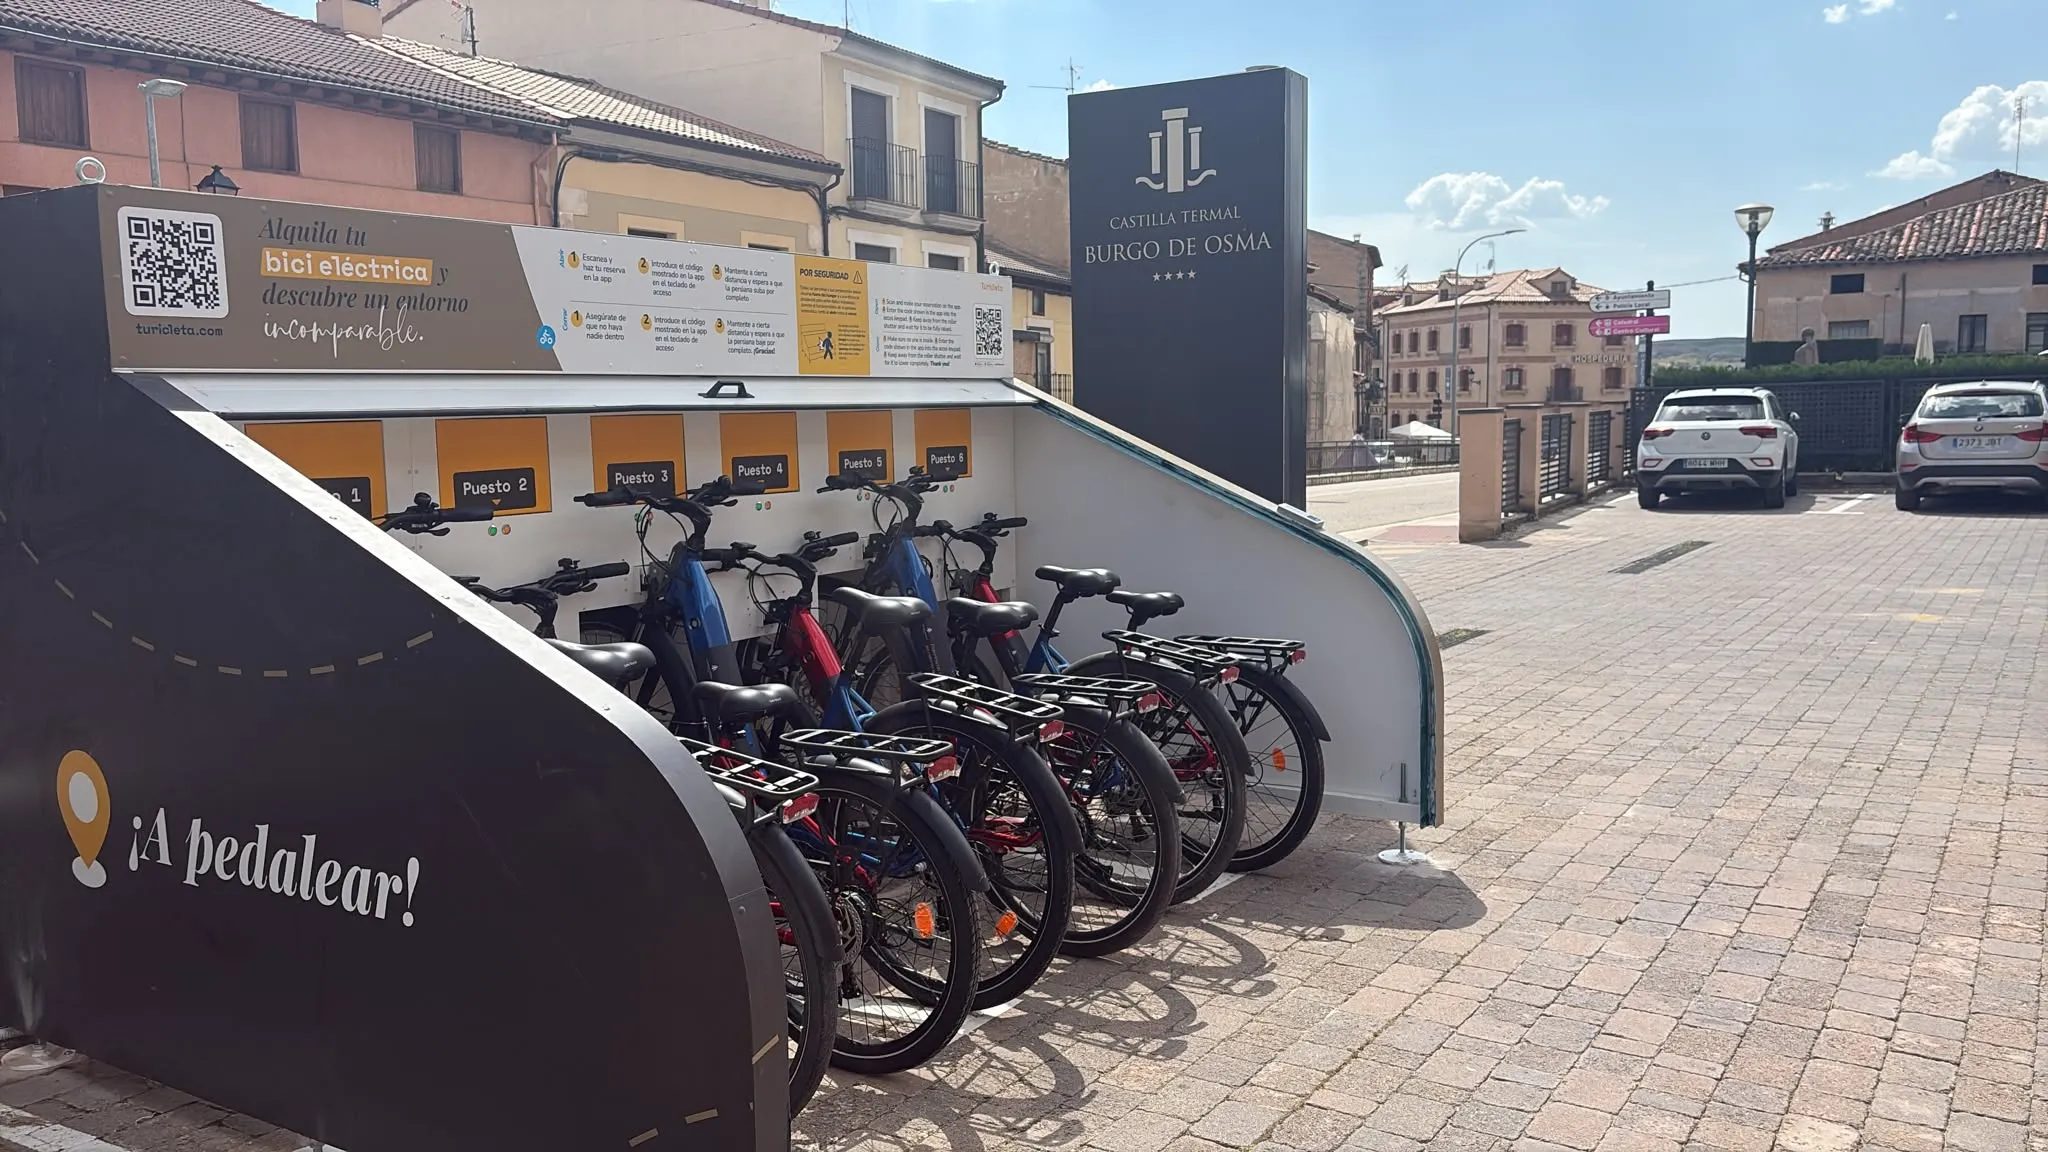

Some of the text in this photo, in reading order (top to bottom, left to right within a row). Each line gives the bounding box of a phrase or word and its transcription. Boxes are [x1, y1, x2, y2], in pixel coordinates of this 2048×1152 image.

[1110, 206, 1240, 230] CASTILLA TERMAL
[258, 218, 368, 246] Alquila tu
[1085, 232, 1272, 264] BURGO DE OSMA
[582, 253, 608, 263] Escanea
[266, 251, 449, 286] bici eléctrica y
[652, 260, 678, 269] Introduce
[685, 264, 703, 272] código
[724, 267, 748, 275] Mantente
[800, 268, 848, 280] POR SEGURIDAD
[262, 282, 468, 313] descubre un entorno
[586, 312, 617, 322] Asegúrate
[654, 316, 680, 324] Introduce
[688, 318, 706, 326] código
[136, 322, 223, 336] turicleta.com
[264, 303, 424, 358] incomparable.
[844, 457, 882, 470] Puesto 5
[930, 454, 964, 464] Puesto 6
[738, 463, 783, 476] Puesto 4
[614, 470, 668, 485] Puesto 3
[462, 478, 528, 496] Puesto 2
[352, 488, 361, 502] 1
[128, 808, 420, 927] ¡A pedalear!
